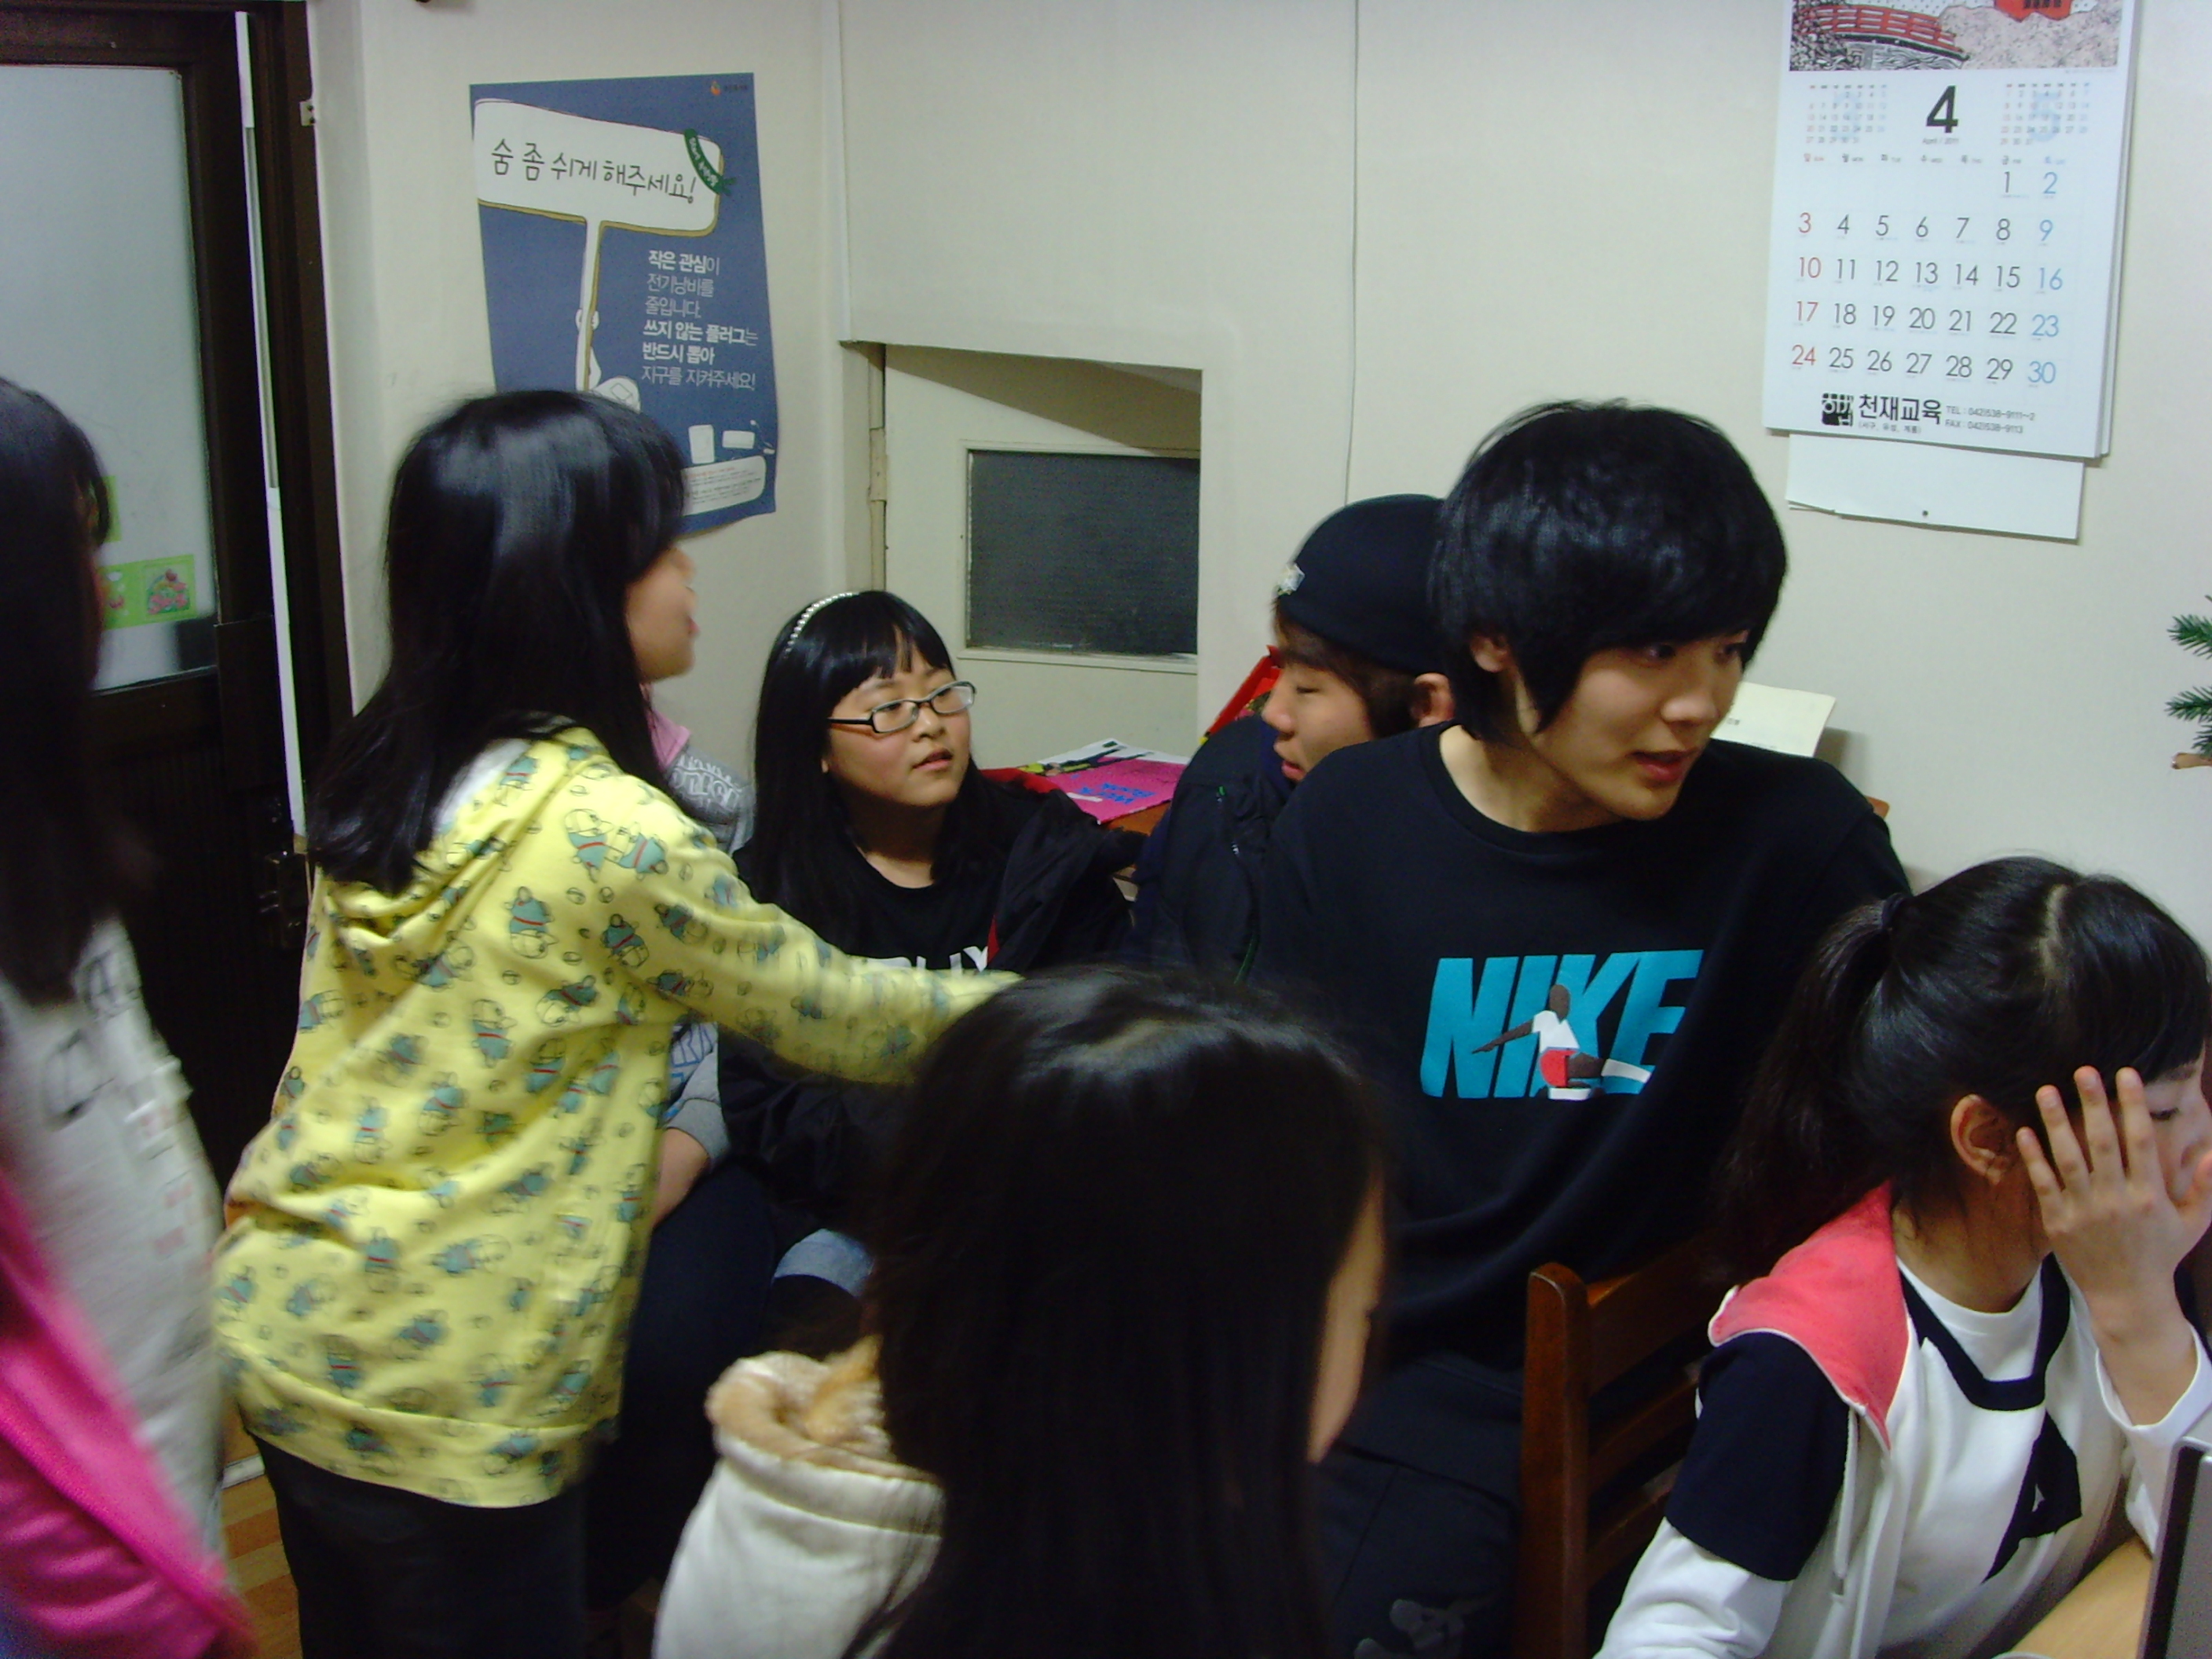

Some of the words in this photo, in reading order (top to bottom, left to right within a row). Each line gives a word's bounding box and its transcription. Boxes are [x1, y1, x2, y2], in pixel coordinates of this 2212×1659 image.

[1925, 85, 1959, 134] 4
[491, 138, 514, 175] 숨
[522, 142, 545, 181] 좀
[551, 152, 597, 180] 쉬게
[602, 160, 697, 204] 해주세요!
[2004, 170, 2011, 193] 1
[2042, 171, 2058, 195] 2
[1798, 212, 1811, 234] 3
[1837, 214, 1850, 234] 4
[1875, 214, 1889, 236] 5
[1915, 216, 1928, 238] 6
[1956, 217, 1970, 239] 7
[1996, 218, 2011, 241] 8
[2039, 218, 2054, 241] 9
[648, 250, 676, 270] 작은
[679, 254, 720, 275] 관심이
[1799, 256, 1822, 279] 10
[1837, 258, 1856, 280] 11
[1876, 260, 1899, 282] 12
[1916, 262, 1939, 284] 13
[1956, 263, 1979, 286] 14
[1997, 265, 2020, 288] 15
[2039, 267, 2064, 291] 16
[646, 273, 714, 298] 전기낭비를
[643, 319, 672, 339] 쓰지
[676, 321, 703, 341] 않는
[705, 324, 758, 346] 플러그는
[1796, 300, 1818, 322] 17
[1834, 302, 1857, 325] 18
[1873, 305, 1895, 327] 19
[1909, 306, 1936, 330] 20
[1949, 309, 1972, 331] 21
[1989, 311, 2017, 335] 22
[2031, 313, 2060, 338] 23
[642, 342, 683, 363] 반드시
[687, 346, 716, 365] 뽑아
[1792, 344, 1817, 366] 24
[1829, 346, 1854, 369] 25
[1866, 349, 1892, 372] 26
[1906, 352, 1933, 374] 27
[1945, 354, 1972, 378] 28
[1986, 357, 2013, 380] 29
[2027, 360, 2056, 384] 30
[642, 366, 683, 386] 지구를
[1859, 394, 1943, 425] 천재교육
[1420, 950, 1704, 1098] NIKE
